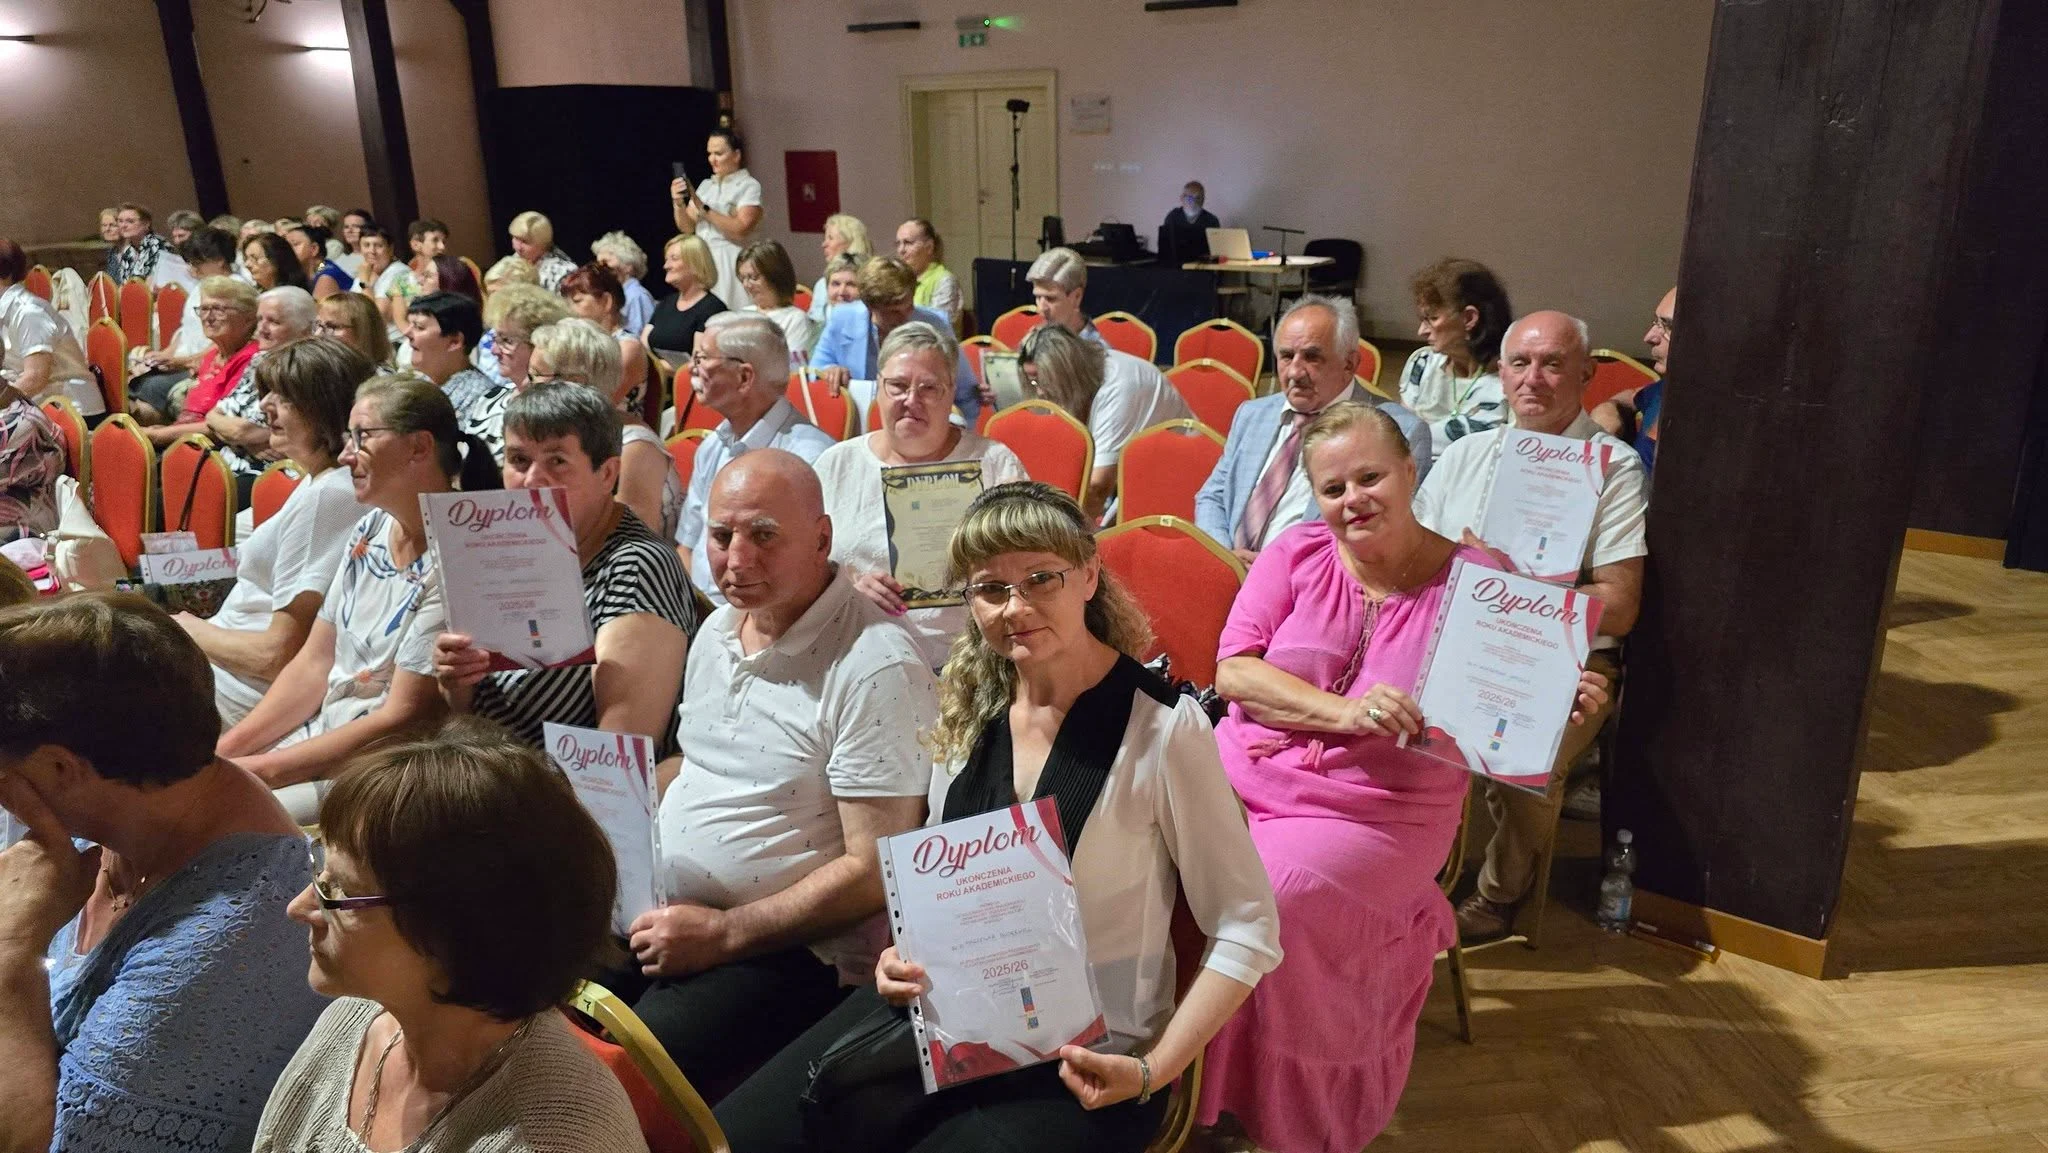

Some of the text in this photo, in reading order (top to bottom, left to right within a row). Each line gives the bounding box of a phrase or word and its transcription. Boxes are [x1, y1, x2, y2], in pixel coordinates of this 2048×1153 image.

[1516, 437, 1596, 466] Dyplom
[448, 499, 554, 532] Dyplom
[163, 557, 239, 580] Dyplom
[1472, 577, 1582, 625] Dyplom
[557, 734, 634, 771] Dyplom
[912, 824, 1041, 878] Dyplom
[936, 870, 1036, 901] ROKU AKADEMICKIEGO
[982, 959, 1029, 979] 2025/26
